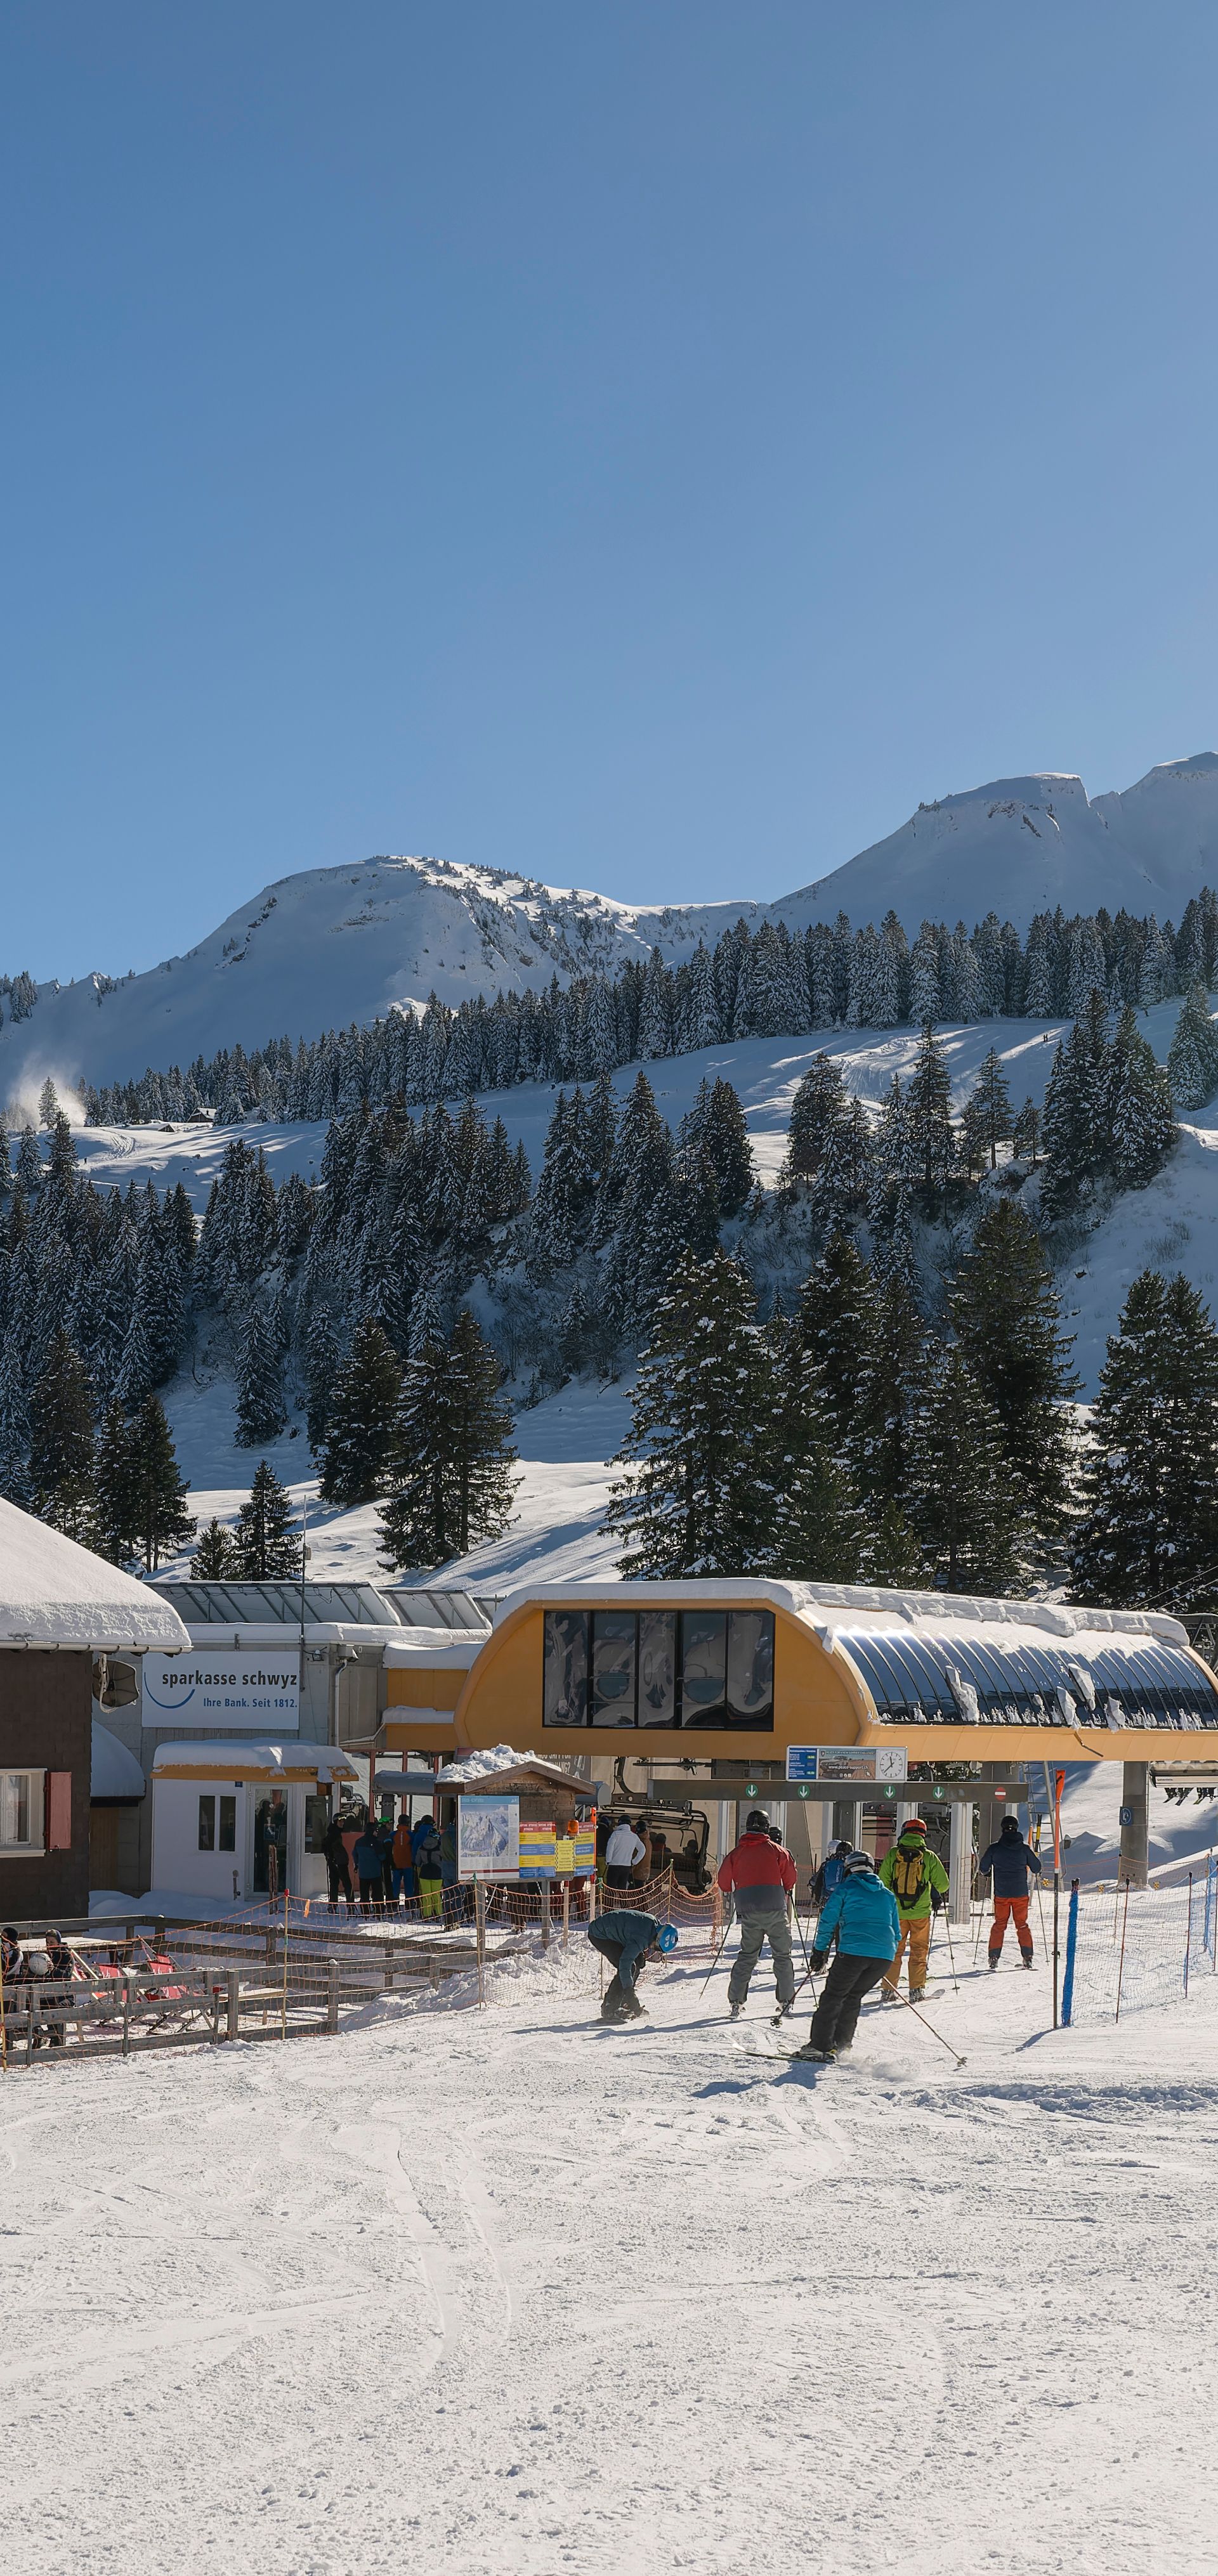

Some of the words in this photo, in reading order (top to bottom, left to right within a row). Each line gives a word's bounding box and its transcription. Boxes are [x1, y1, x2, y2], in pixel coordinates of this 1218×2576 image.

[162, 1670, 237, 1688] sparkasse
[242, 1670, 297, 1689] schwyz
[203, 1698, 221, 1707] Ihre
[225, 1698, 249, 1707] Bank.
[252, 1698, 270, 1707] Seit
[273, 1699, 298, 1708] 1812.
